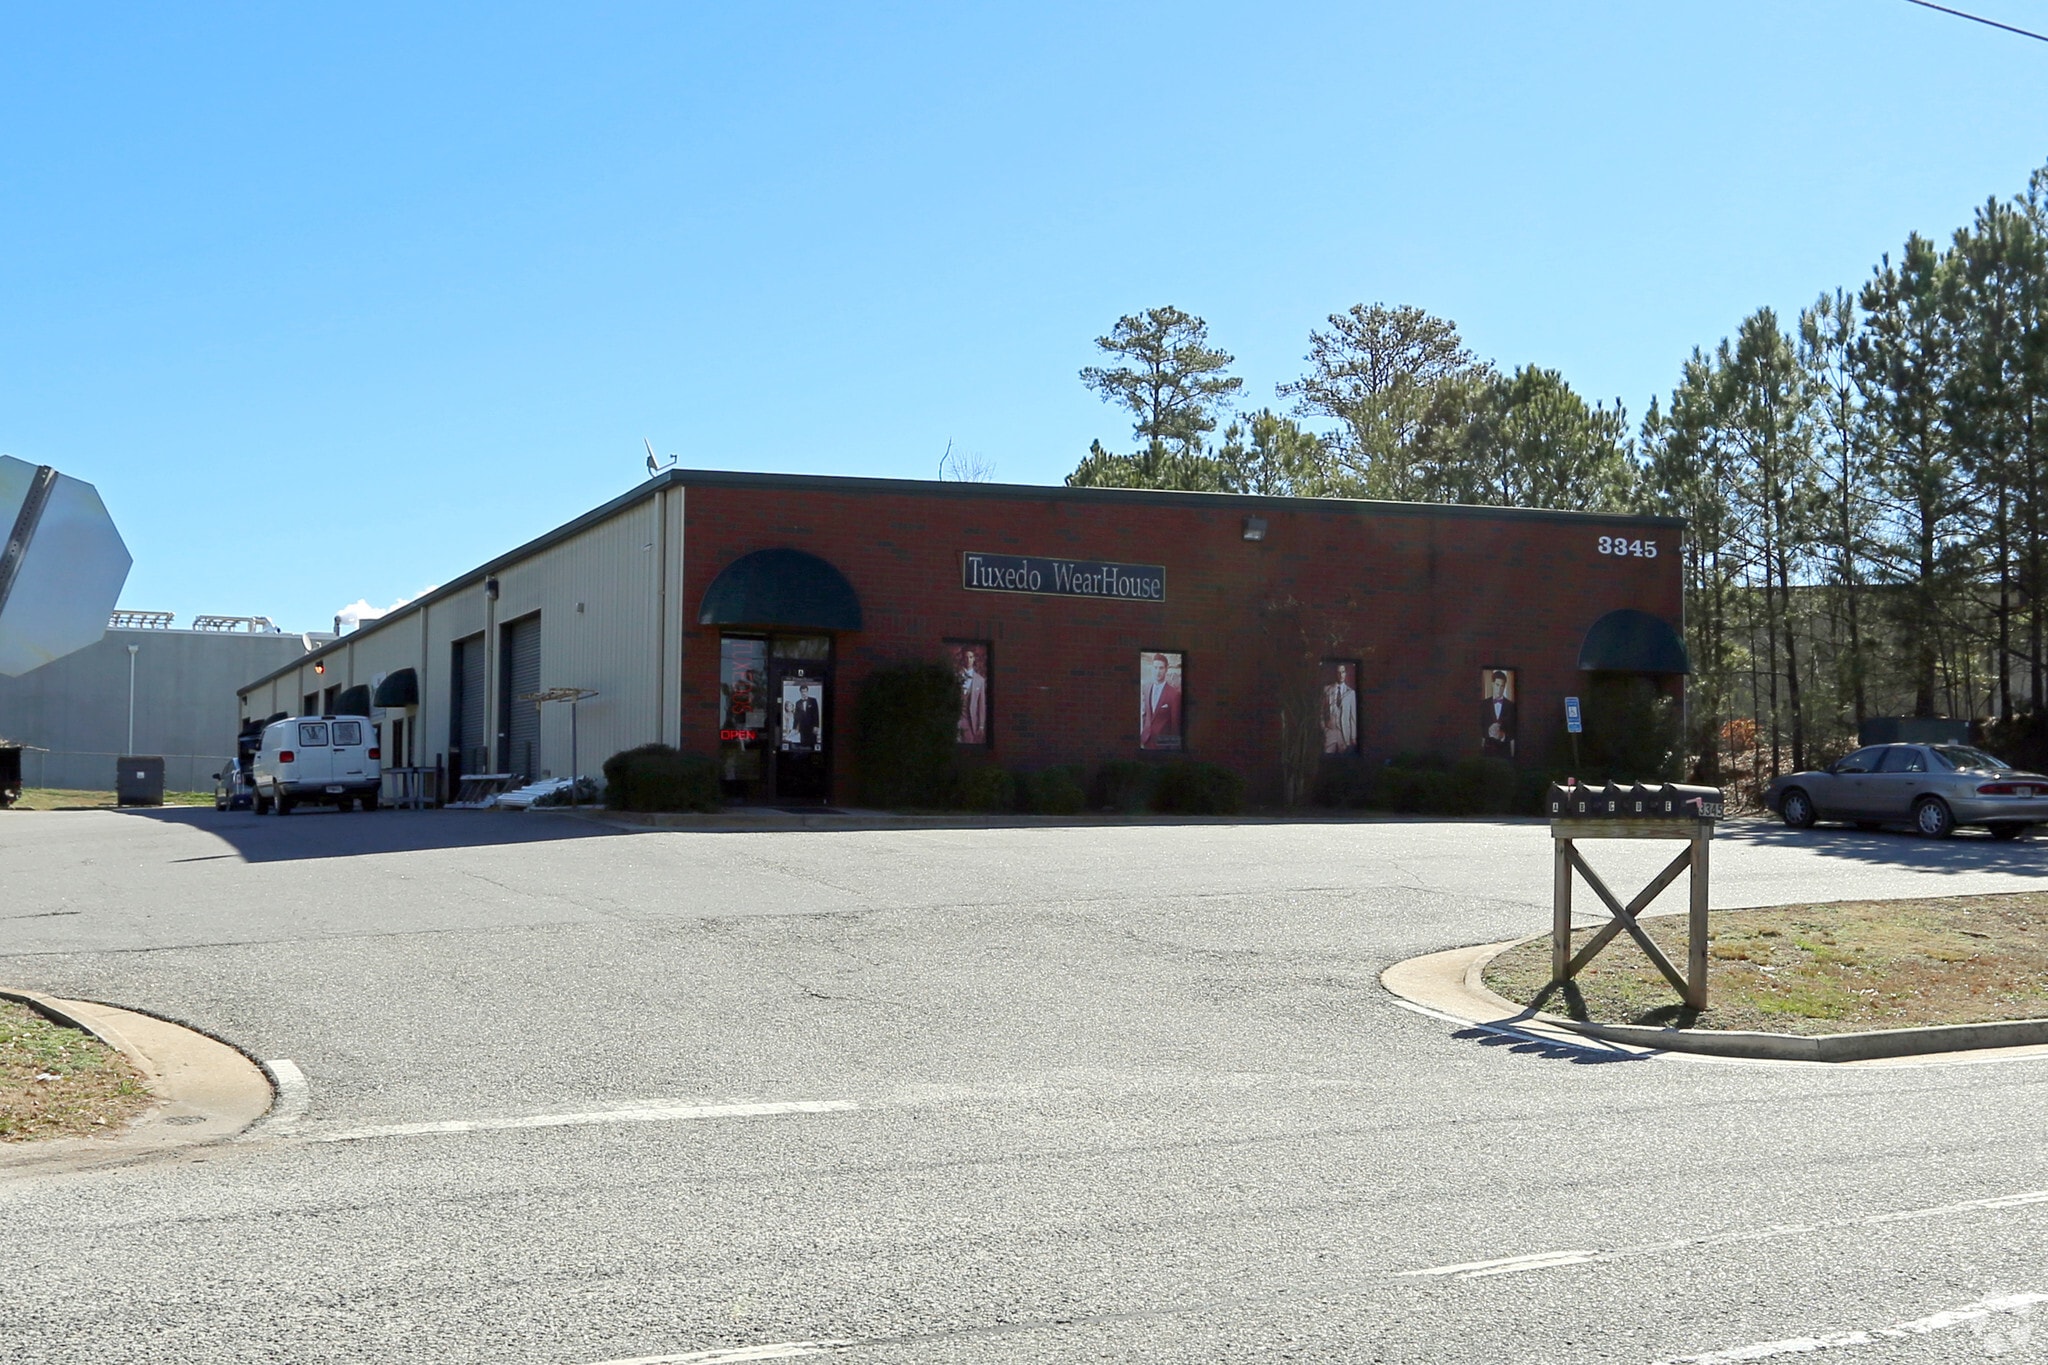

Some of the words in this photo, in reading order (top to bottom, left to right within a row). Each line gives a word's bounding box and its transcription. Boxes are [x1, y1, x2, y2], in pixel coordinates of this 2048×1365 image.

[1598, 536, 1657, 558] 3345
[968, 556, 1041, 591] Tuxedo
[1053, 562, 1161, 599] WearHouse
[731, 641, 754, 715] TUXEDOS
[720, 729, 757, 741] OPEN
